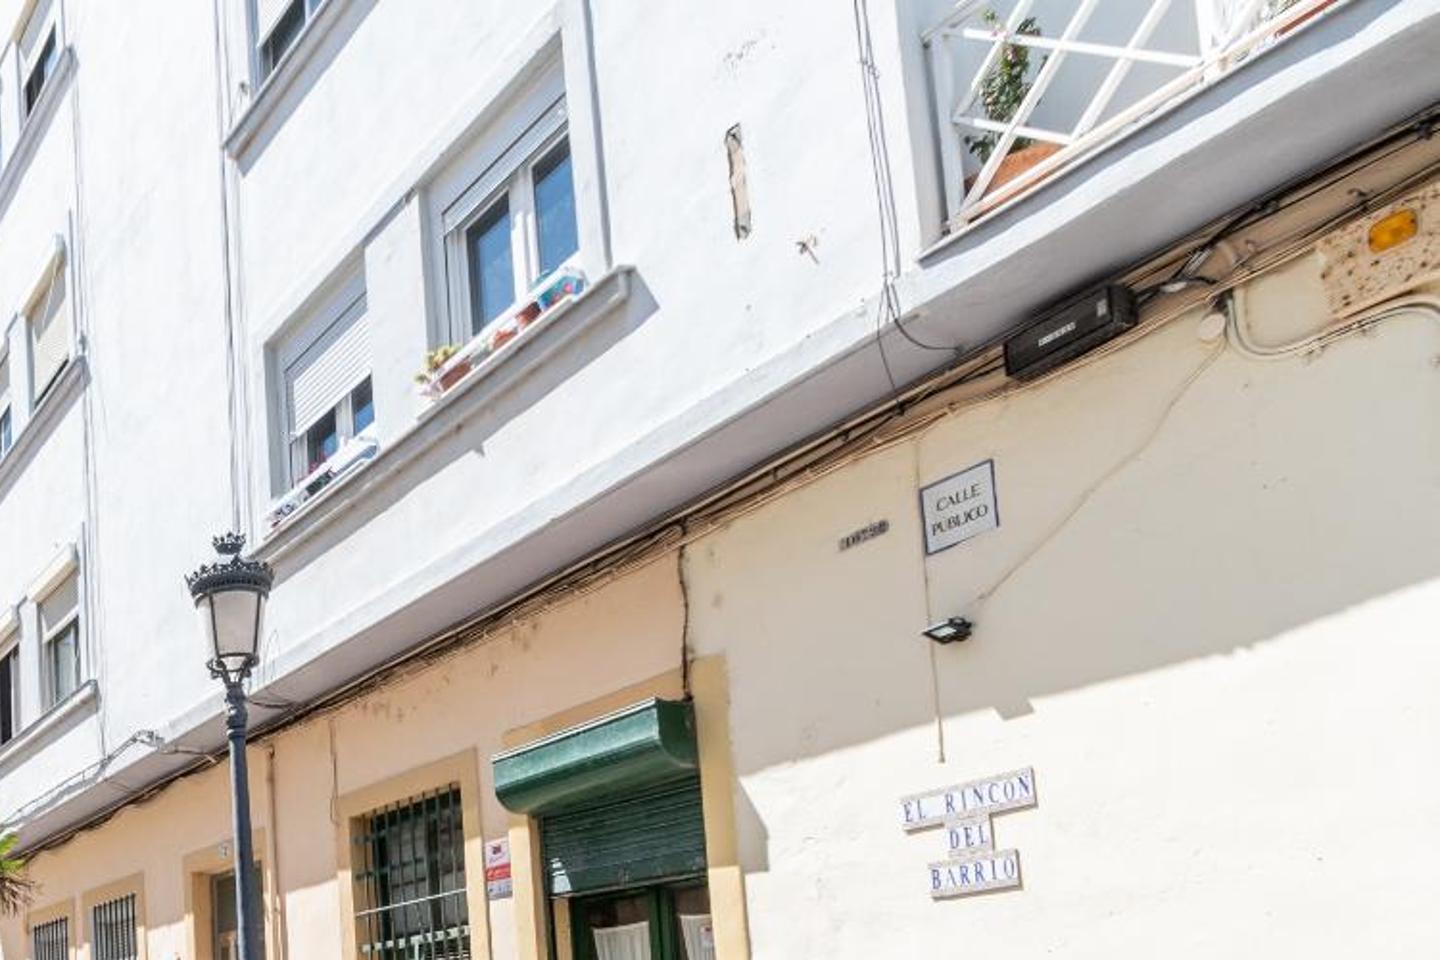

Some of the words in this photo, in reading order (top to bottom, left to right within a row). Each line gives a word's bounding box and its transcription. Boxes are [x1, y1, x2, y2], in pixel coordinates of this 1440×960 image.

[936, 483, 981, 512] CALLE
[931, 503, 989, 536] PUBLICO
[903, 799, 927, 823] EL
[945, 775, 1031, 814] RINCON
[949, 824, 987, 849] DEL
[931, 857, 1016, 890] BARRIO
